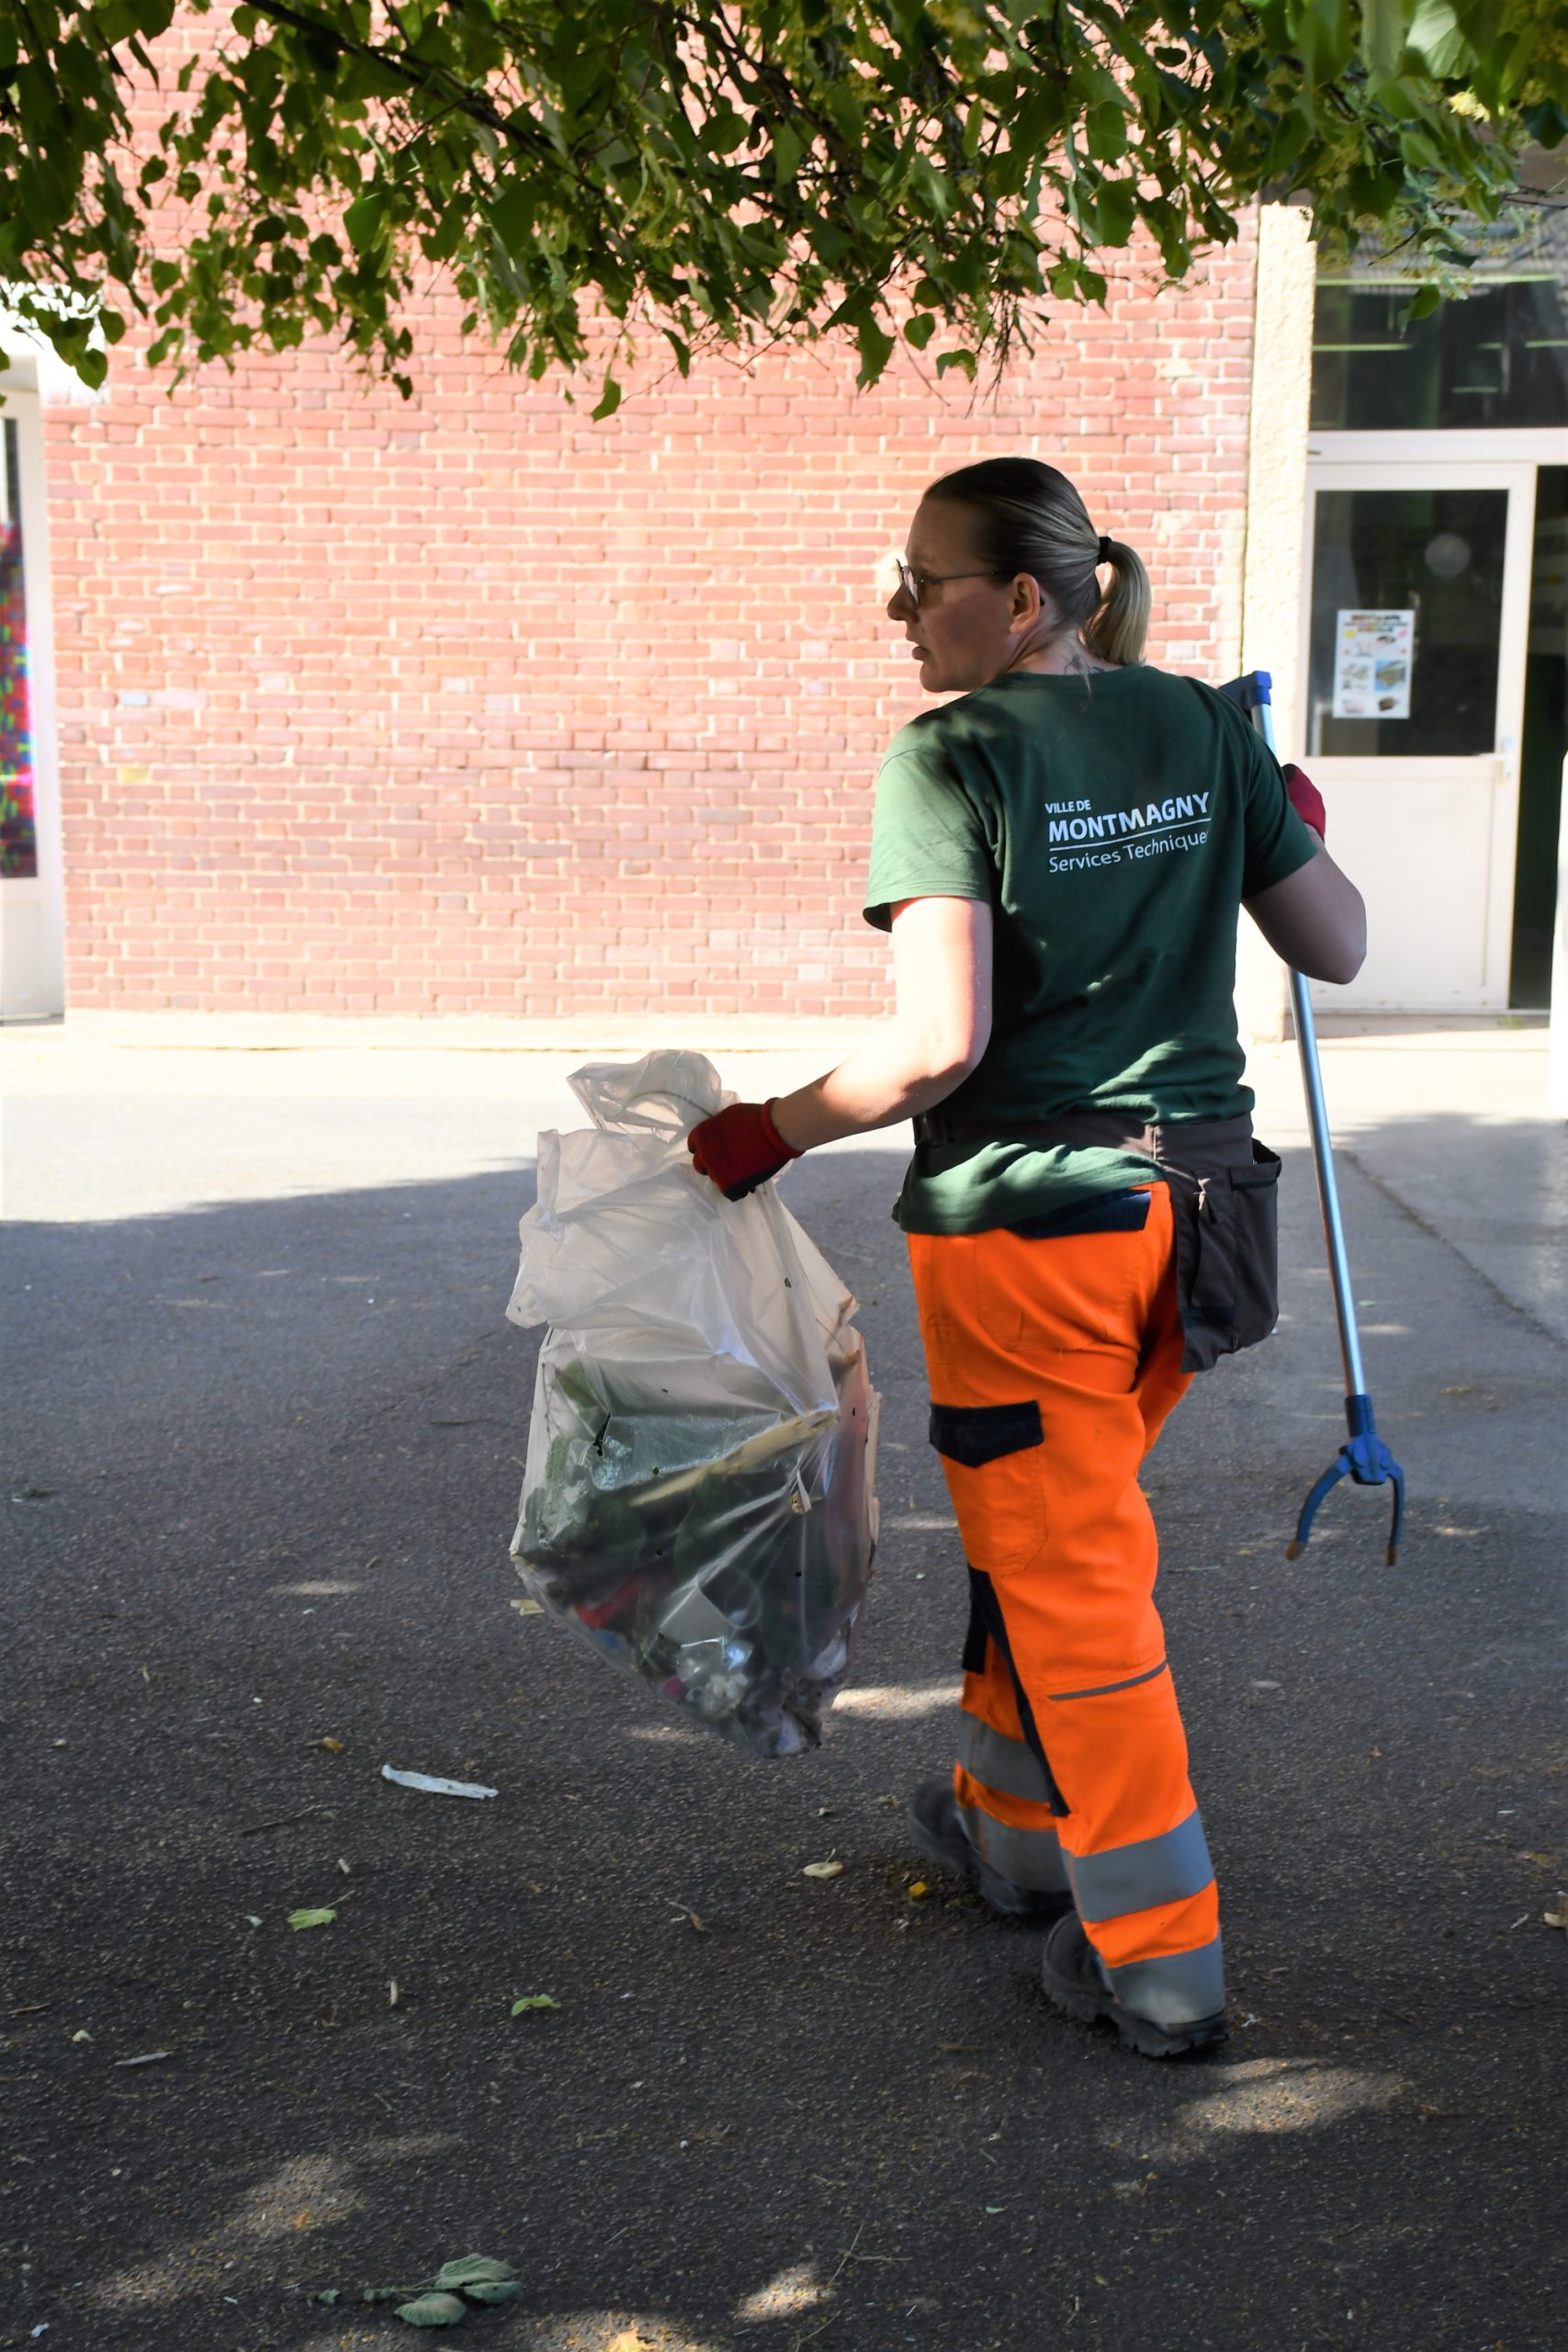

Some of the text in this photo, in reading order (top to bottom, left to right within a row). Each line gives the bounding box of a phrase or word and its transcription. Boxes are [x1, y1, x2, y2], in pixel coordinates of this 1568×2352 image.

[1044, 799, 1091, 814] VILLE DE
[1049, 792, 1210, 842] MONTMAGNY
[1049, 831, 1209, 873] Services Technique
